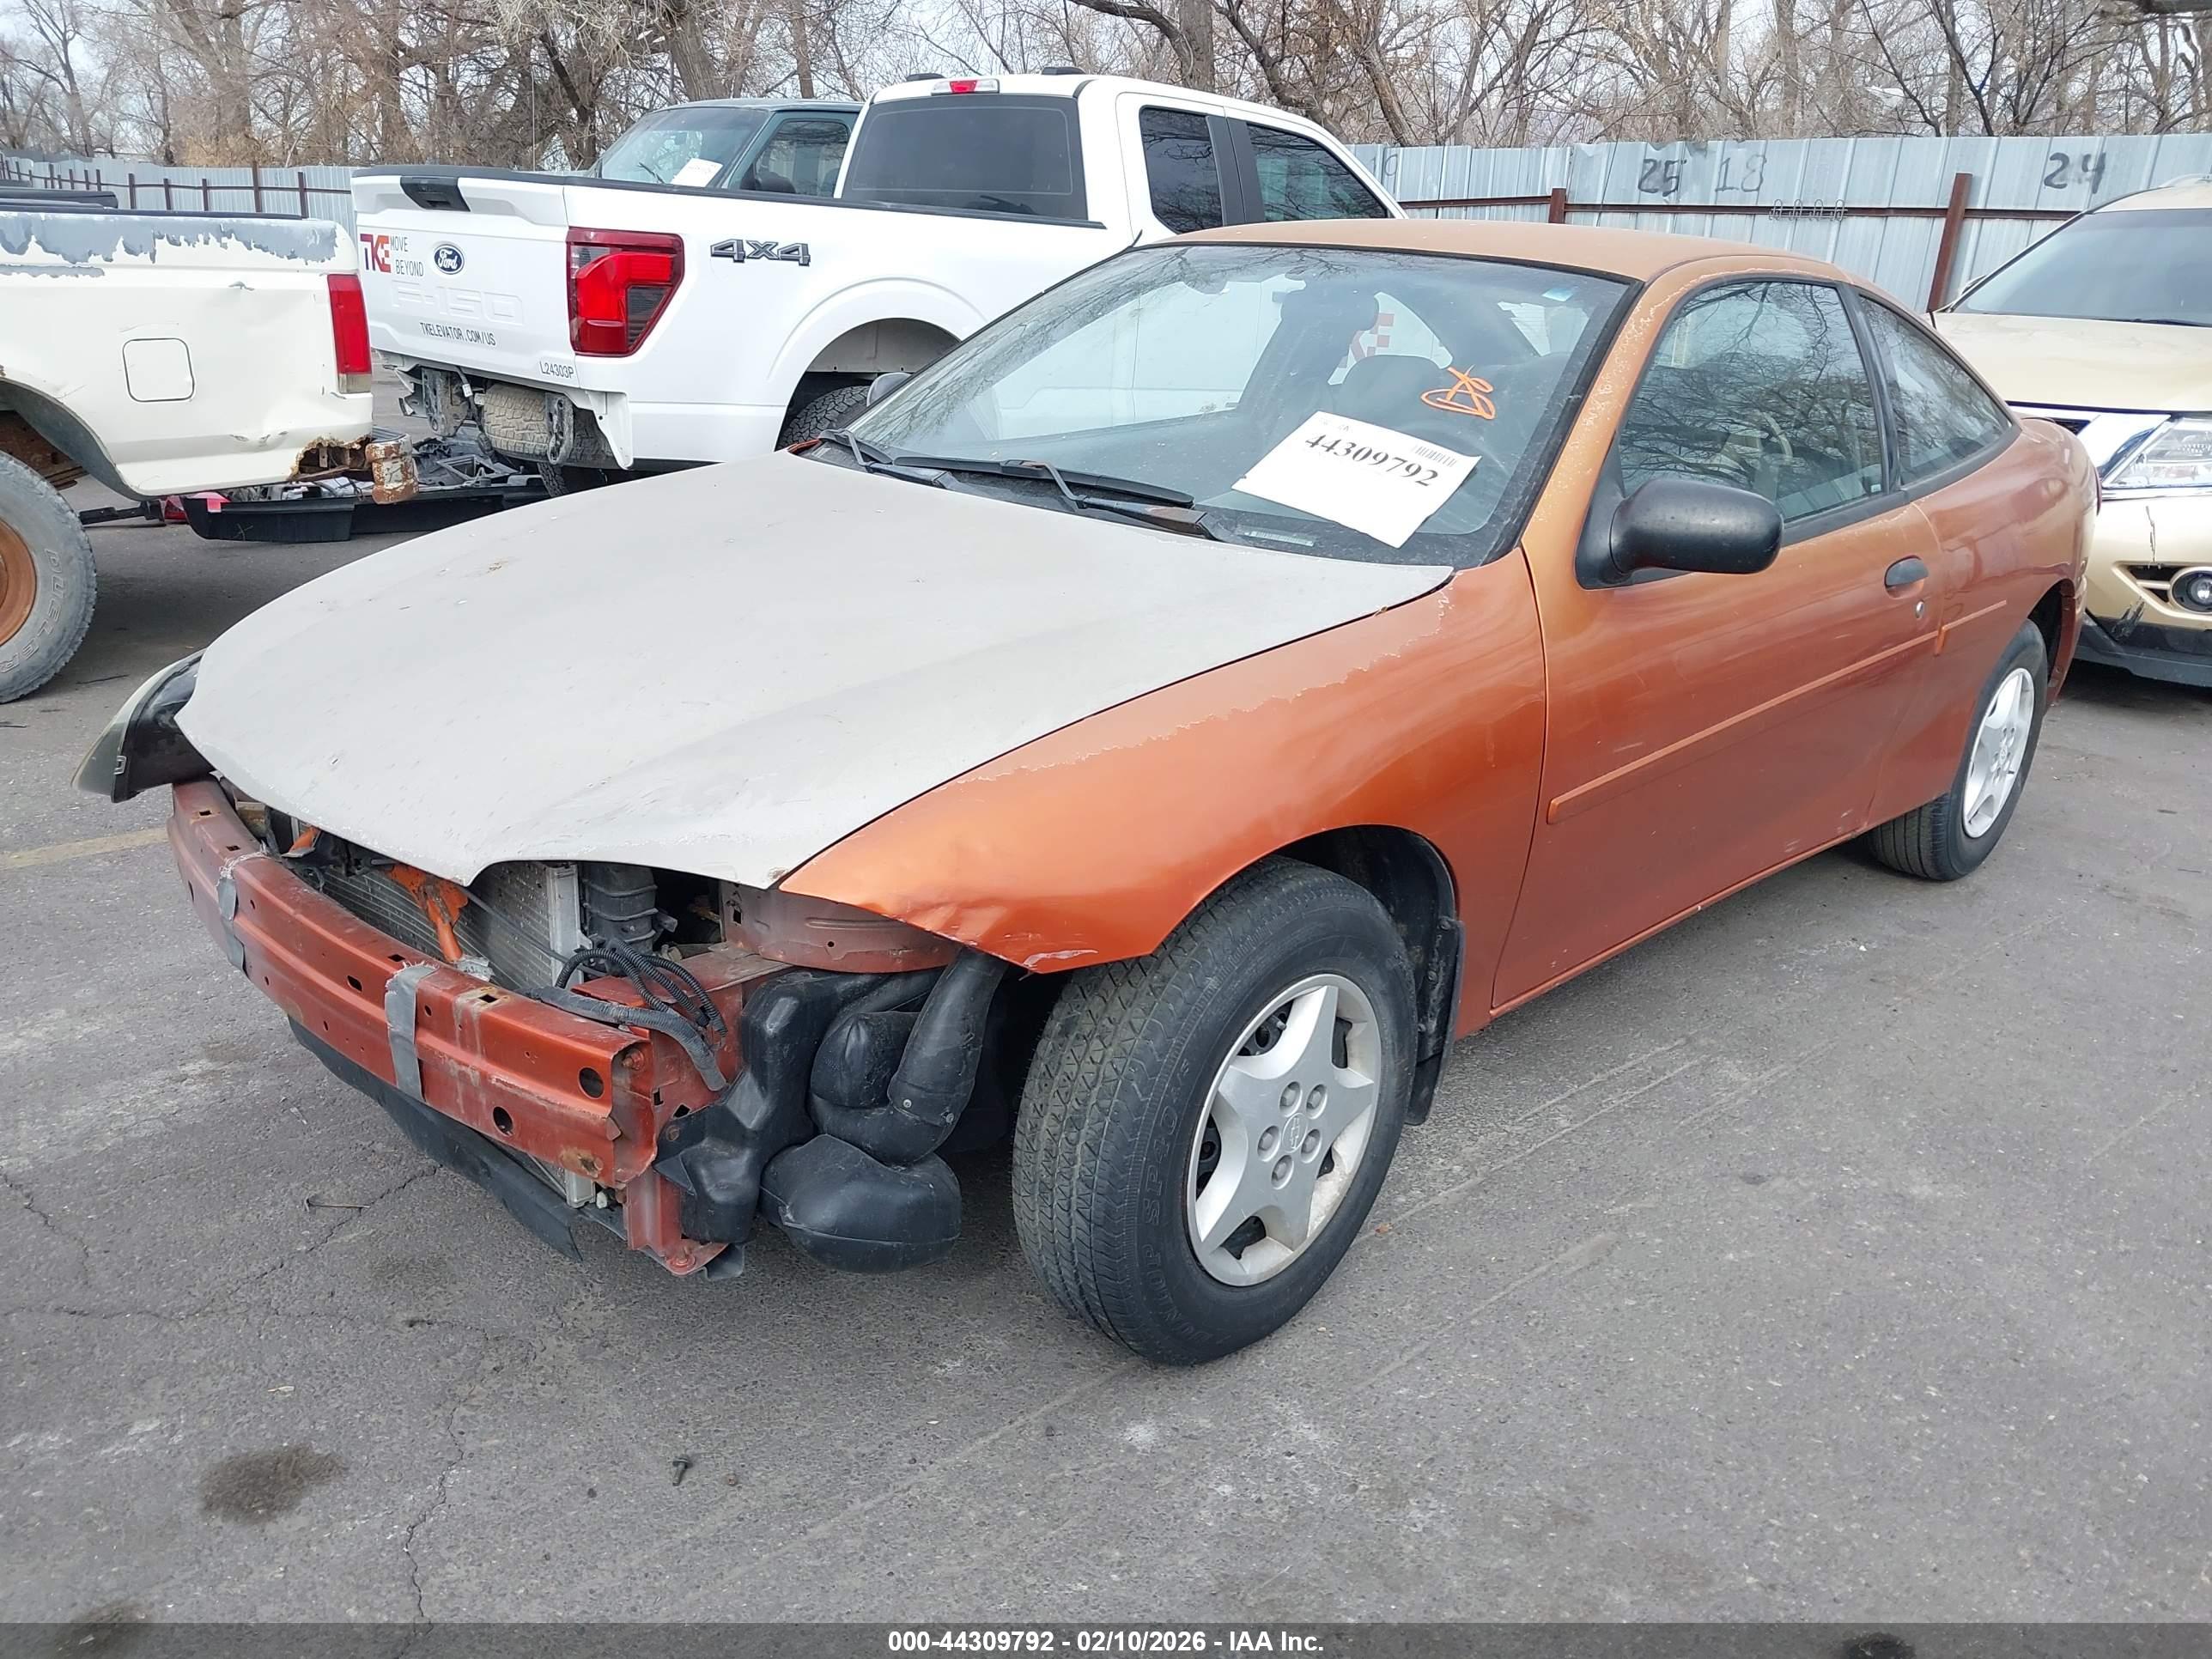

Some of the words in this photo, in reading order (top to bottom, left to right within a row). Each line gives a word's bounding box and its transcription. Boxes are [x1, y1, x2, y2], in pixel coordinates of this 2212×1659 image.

[1638, 158, 1687, 198] 25
[1715, 154, 1767, 192] 18
[2044, 152, 2106, 194] 24
[390, 235, 409, 252] MOVE
[436, 246, 460, 271] Ford
[395, 259, 424, 276] BEYOND
[391, 280, 524, 325] F-150
[419, 322, 496, 345] TKELEVATOR.COM/US
[539, 361, 574, 379] L24303P
[1305, 434, 1438, 486] 44309792
